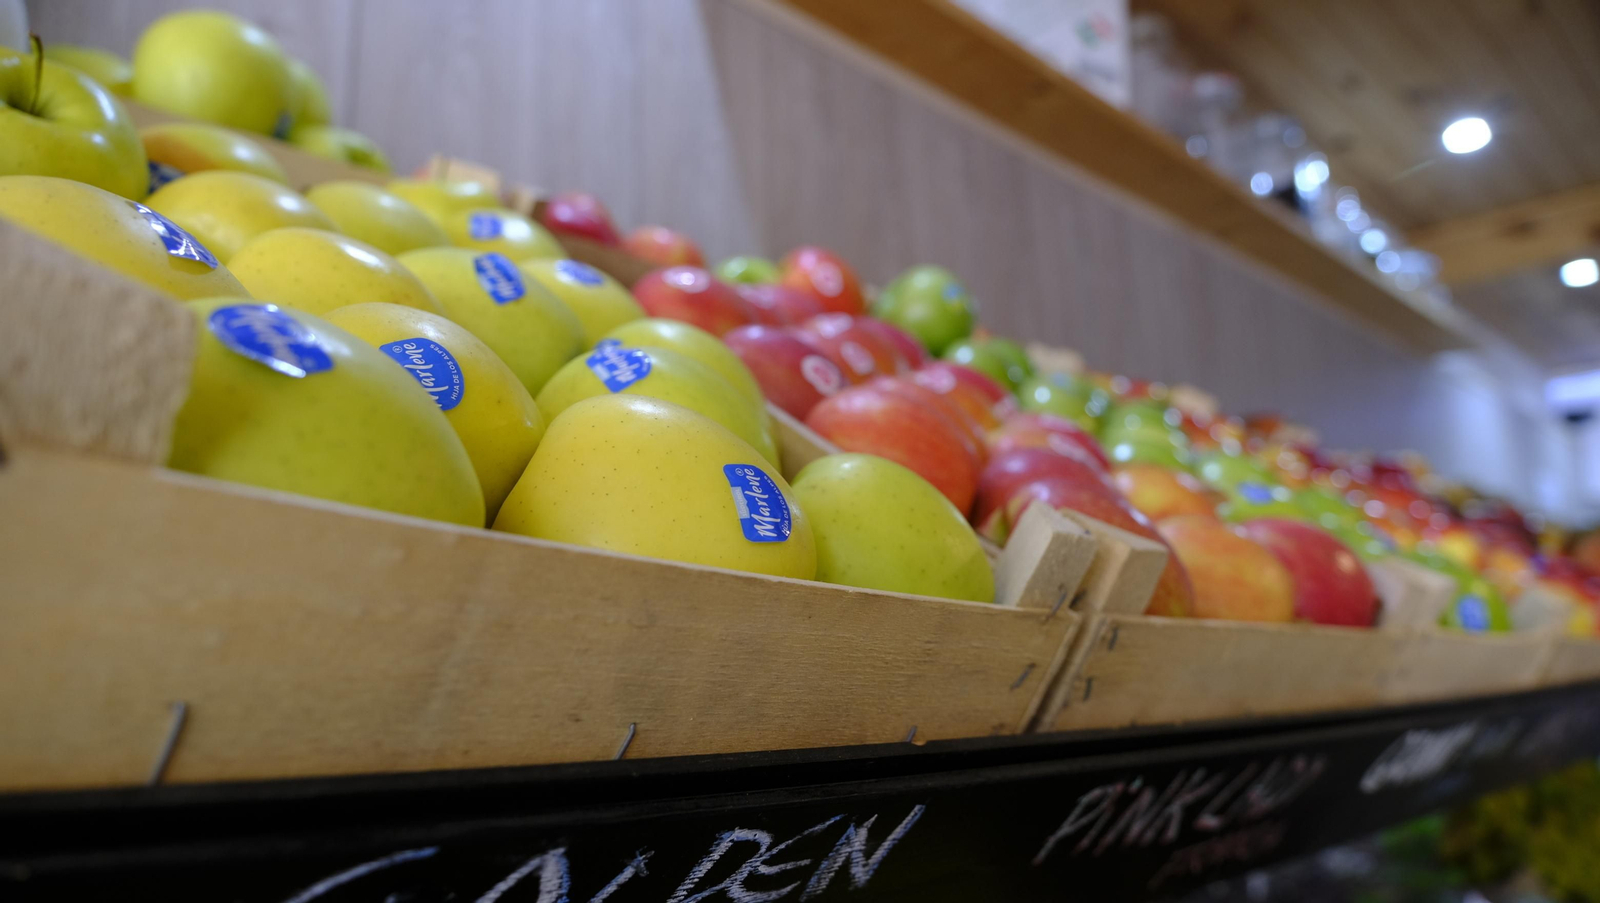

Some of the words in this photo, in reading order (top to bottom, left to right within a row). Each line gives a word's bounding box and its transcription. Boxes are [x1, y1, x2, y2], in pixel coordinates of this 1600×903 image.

[430, 344, 450, 360] ALPES
[446, 361, 457, 374] LOS
[453, 375, 460, 384] DE
[451, 385, 460, 401] HIJA
[744, 468, 781, 537] Marlene
[1030, 766, 1227, 867] PINK
[283, 803, 926, 903] DEN
